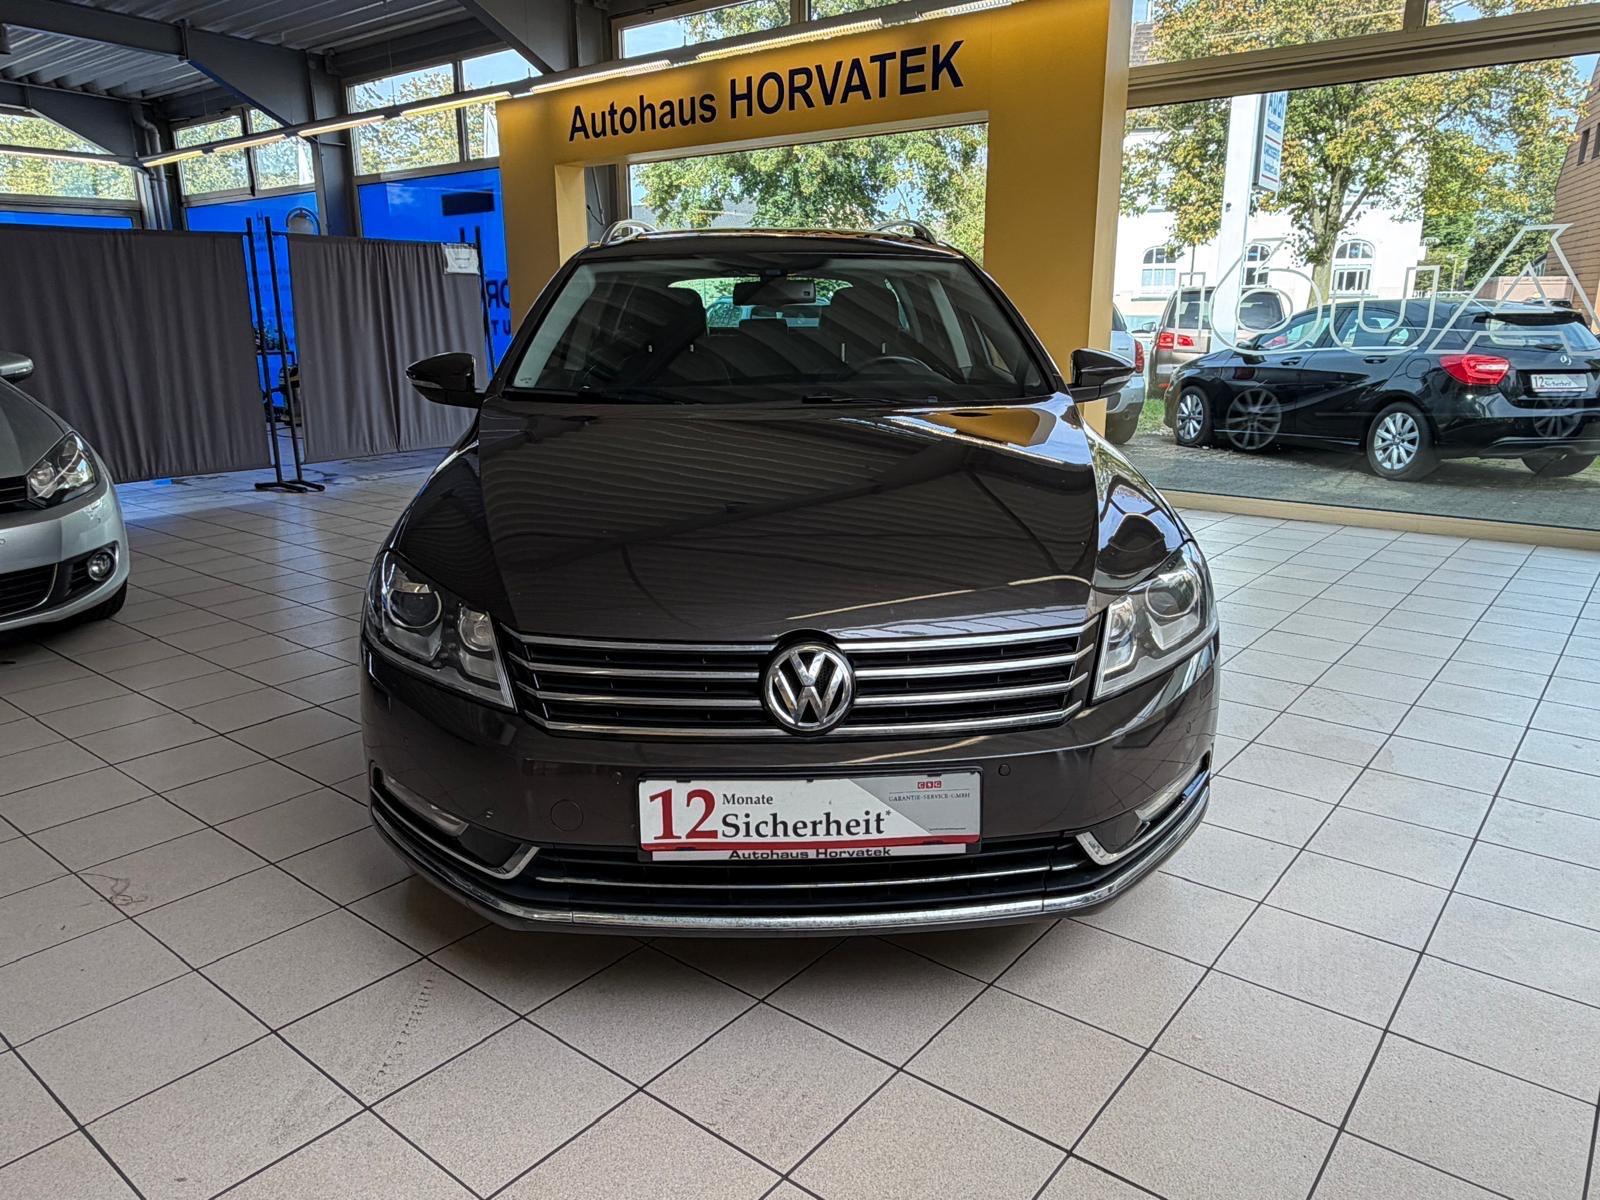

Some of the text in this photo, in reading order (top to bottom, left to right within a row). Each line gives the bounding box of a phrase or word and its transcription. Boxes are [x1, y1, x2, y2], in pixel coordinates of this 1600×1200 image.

[568, 39, 964, 142] Autohaus HORVATEK
[648, 787, 719, 841] 12
[721, 793, 774, 806] Monate
[728, 846, 892, 861] Autohaus Horvatek
